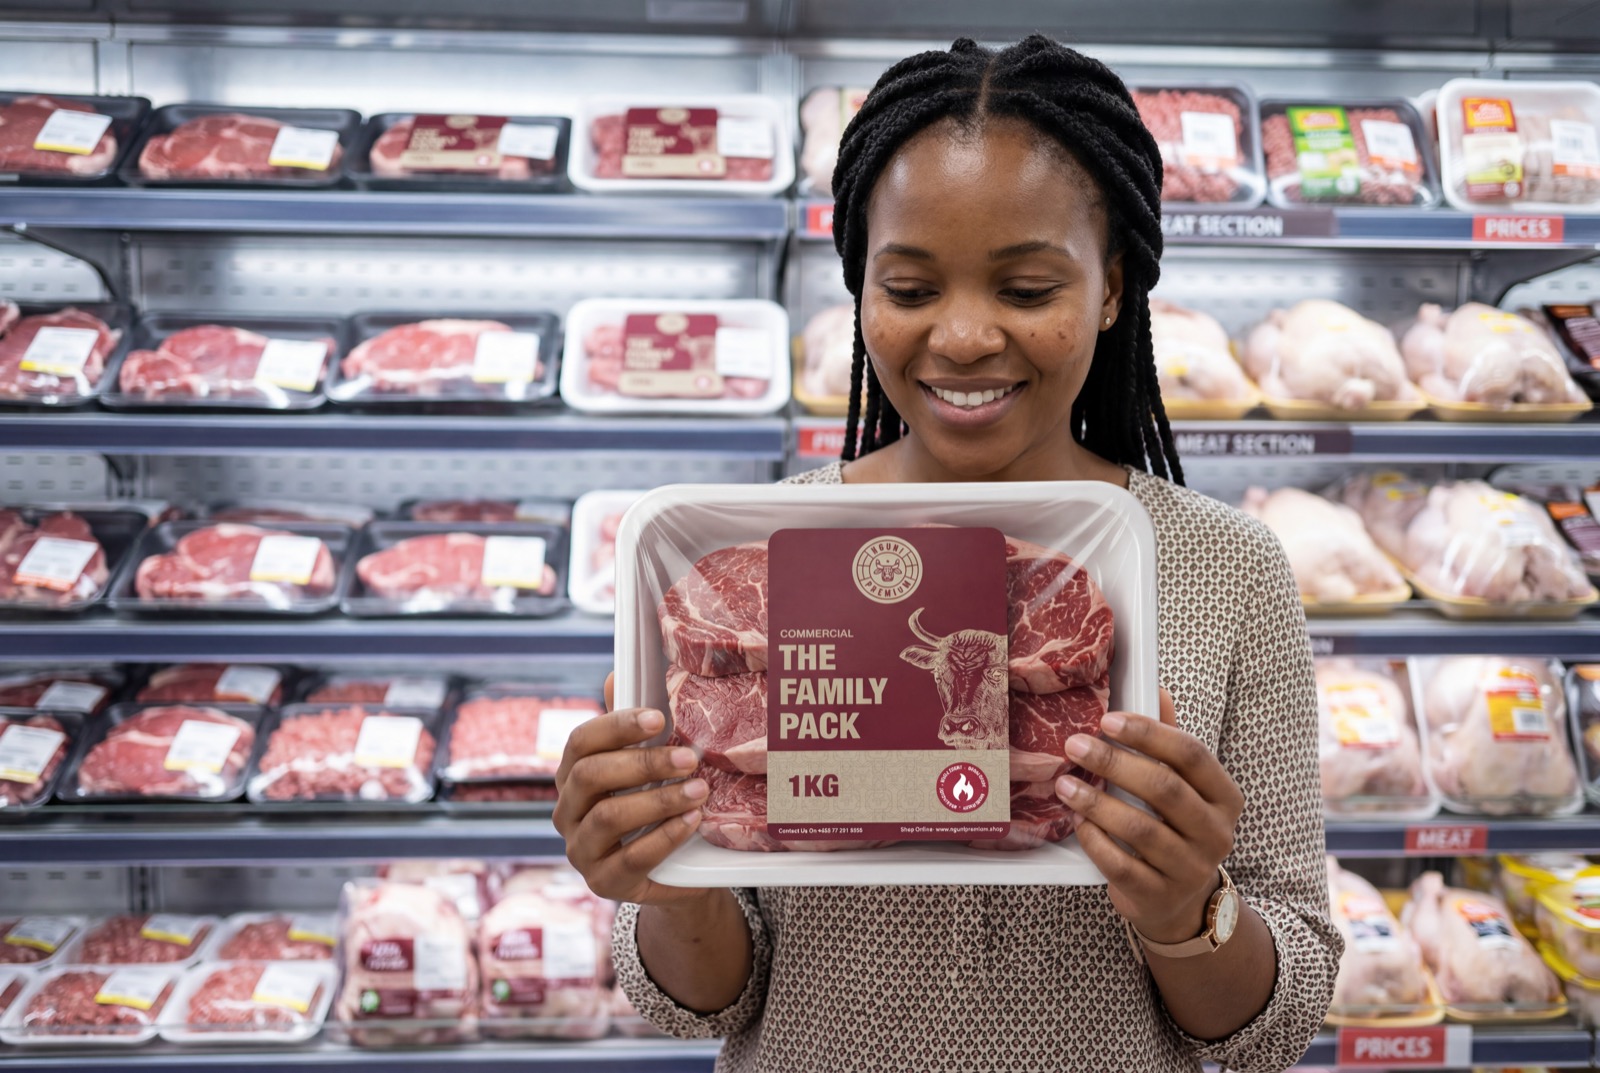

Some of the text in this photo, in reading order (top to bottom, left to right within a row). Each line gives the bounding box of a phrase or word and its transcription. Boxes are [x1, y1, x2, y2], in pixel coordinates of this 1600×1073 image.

[1160, 214, 1284, 238] EAT SECTION
[1485, 217, 1552, 239] PRICES
[1232, 433, 1316, 456] SECTION
[871, 543, 904, 555] NGUNI
[865, 580, 911, 598] PREMIUM
[780, 629, 854, 638] COMMERCIAL
[778, 644, 836, 670] THE
[780, 677, 888, 705] FAMILY
[780, 712, 861, 739] PACK
[789, 773, 839, 798] 1KG
[1417, 828, 1472, 848] MEAT
[1355, 1037, 1432, 1059] PRICES
